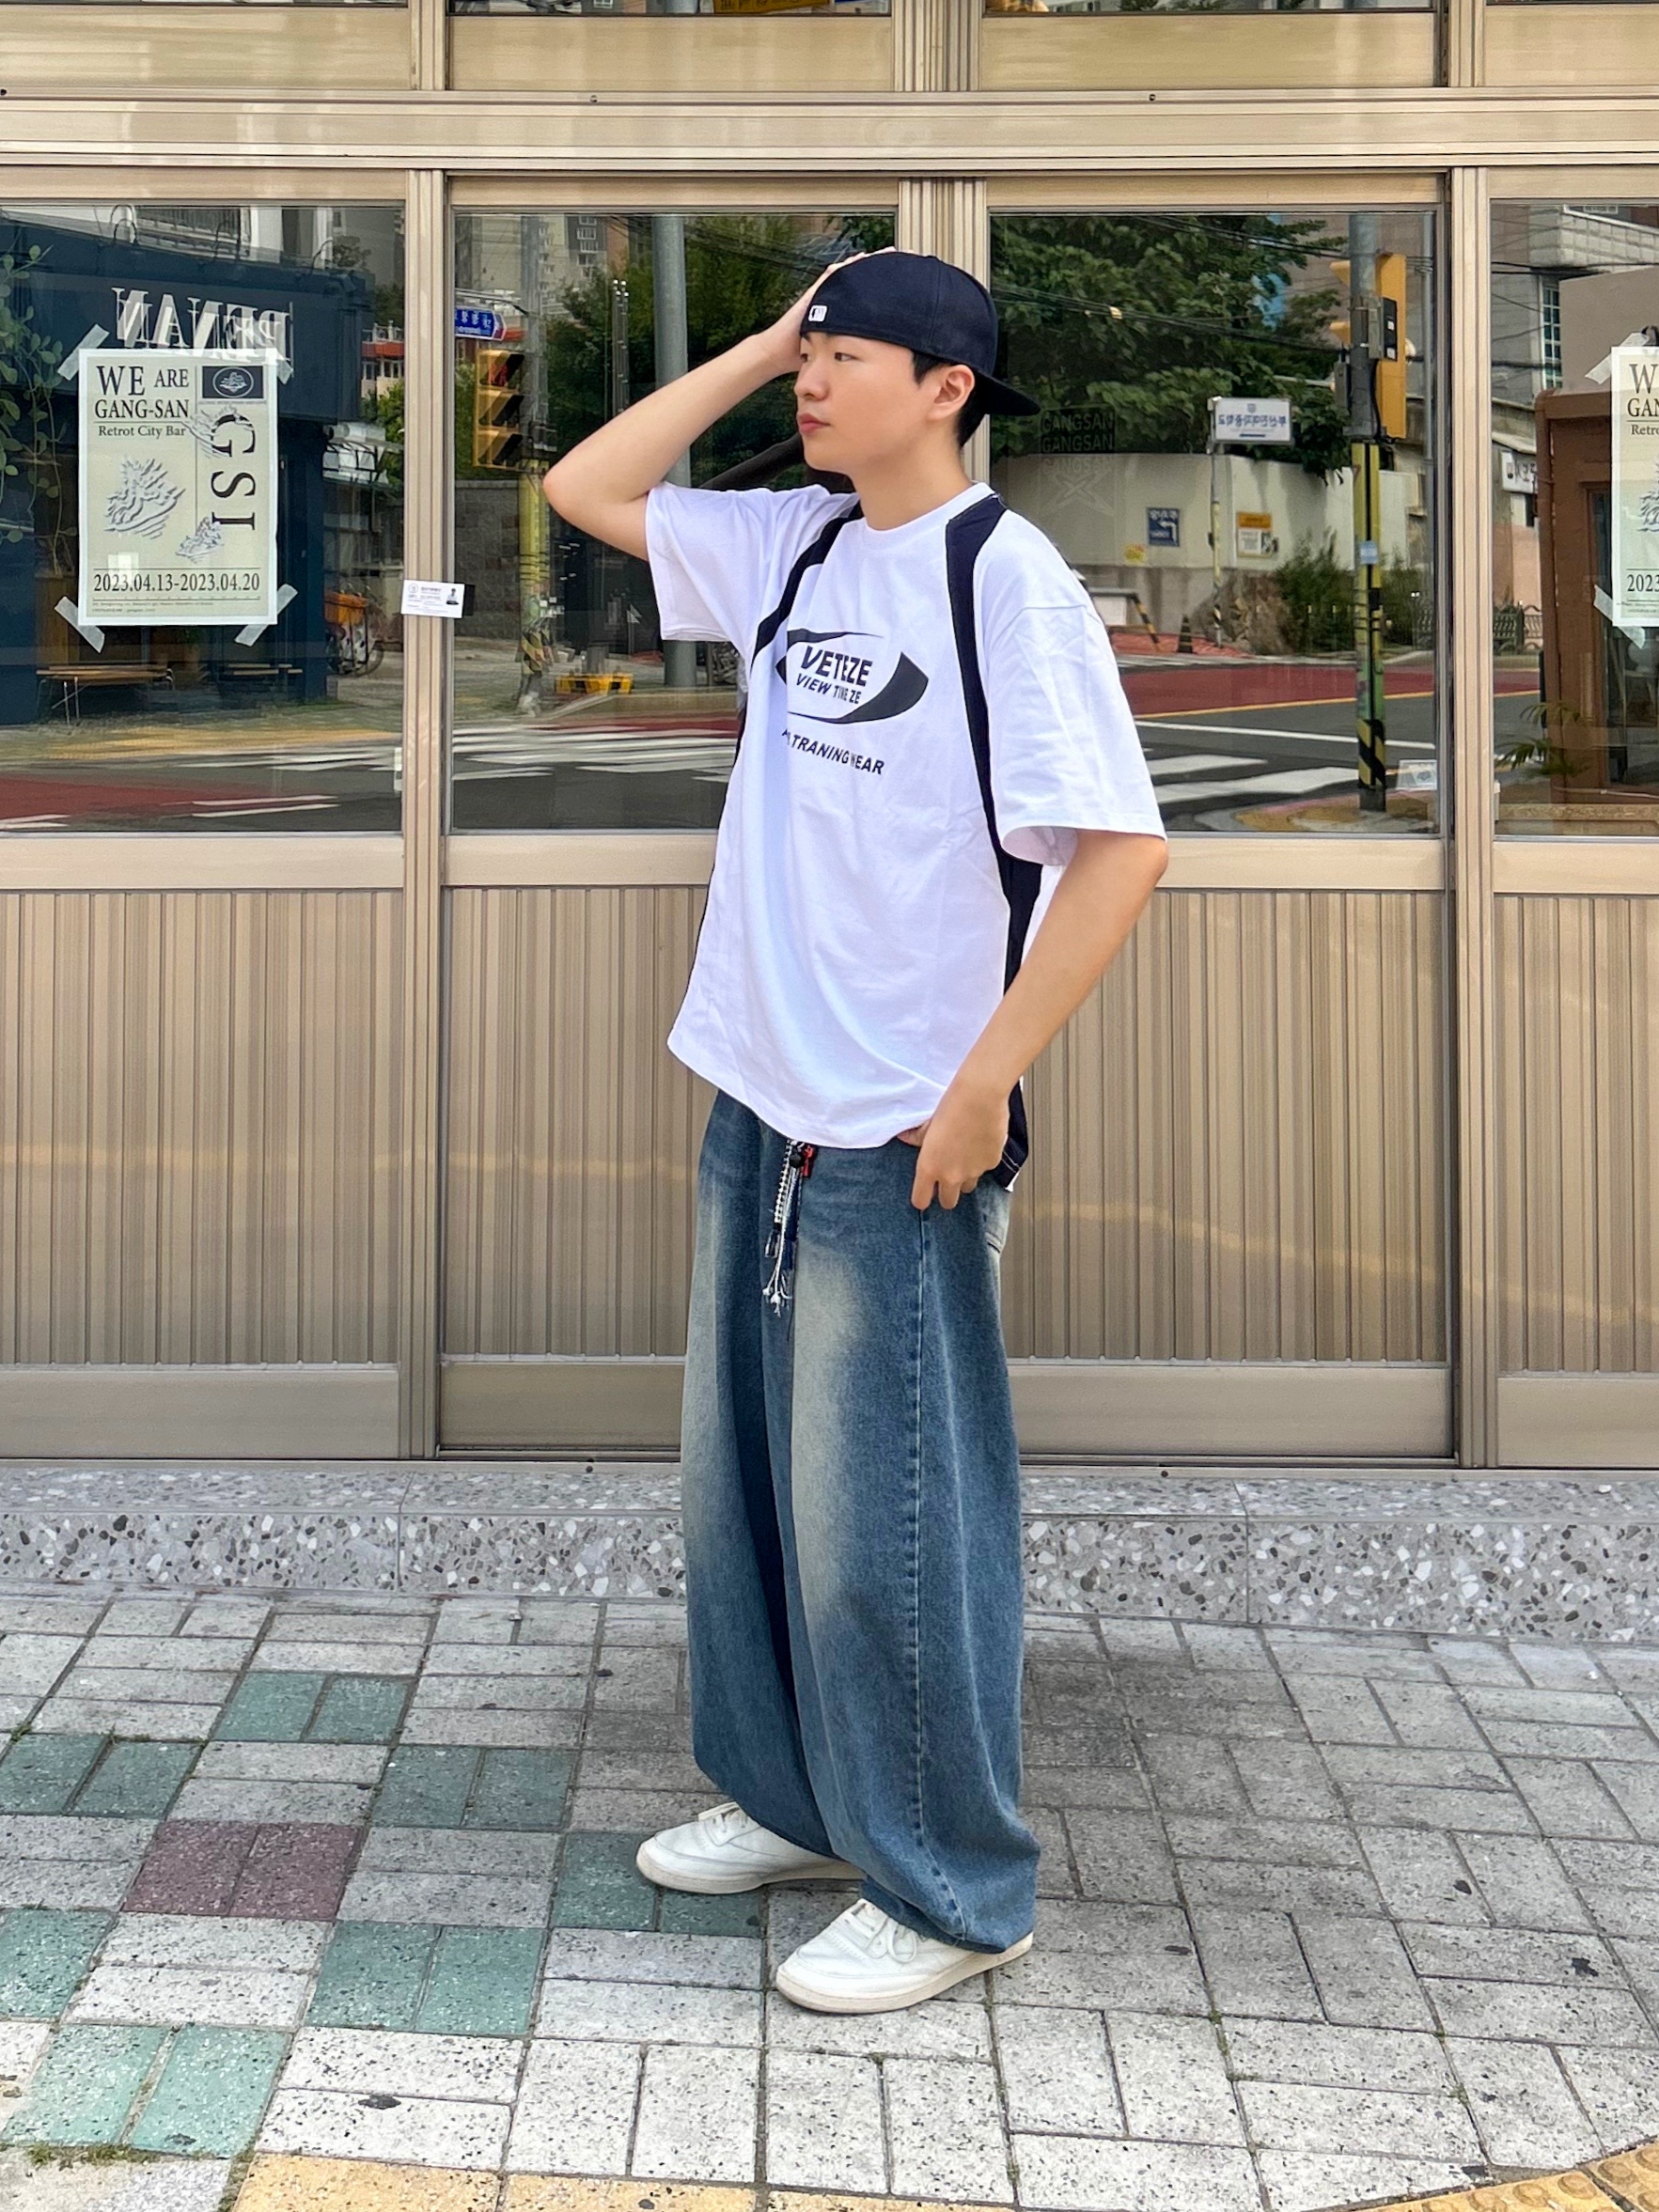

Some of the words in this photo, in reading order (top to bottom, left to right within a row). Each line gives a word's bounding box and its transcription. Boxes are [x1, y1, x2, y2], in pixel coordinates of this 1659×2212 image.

[96, 365, 146, 396] WE
[154, 367, 190, 387] ARE
[95, 398, 190, 419] GANG-SAN
[98, 425, 134, 437] Retrot
[137, 425, 163, 439] City
[165, 425, 187, 437] Bar
[1041, 412, 1114, 432] GANGSAN
[1041, 433, 1114, 453] GANGSAN
[94, 572, 260, 592] 2023.04.13-2023.04.20
[796, 673, 833, 695] VIEW
[849, 689, 862, 704] ZE
